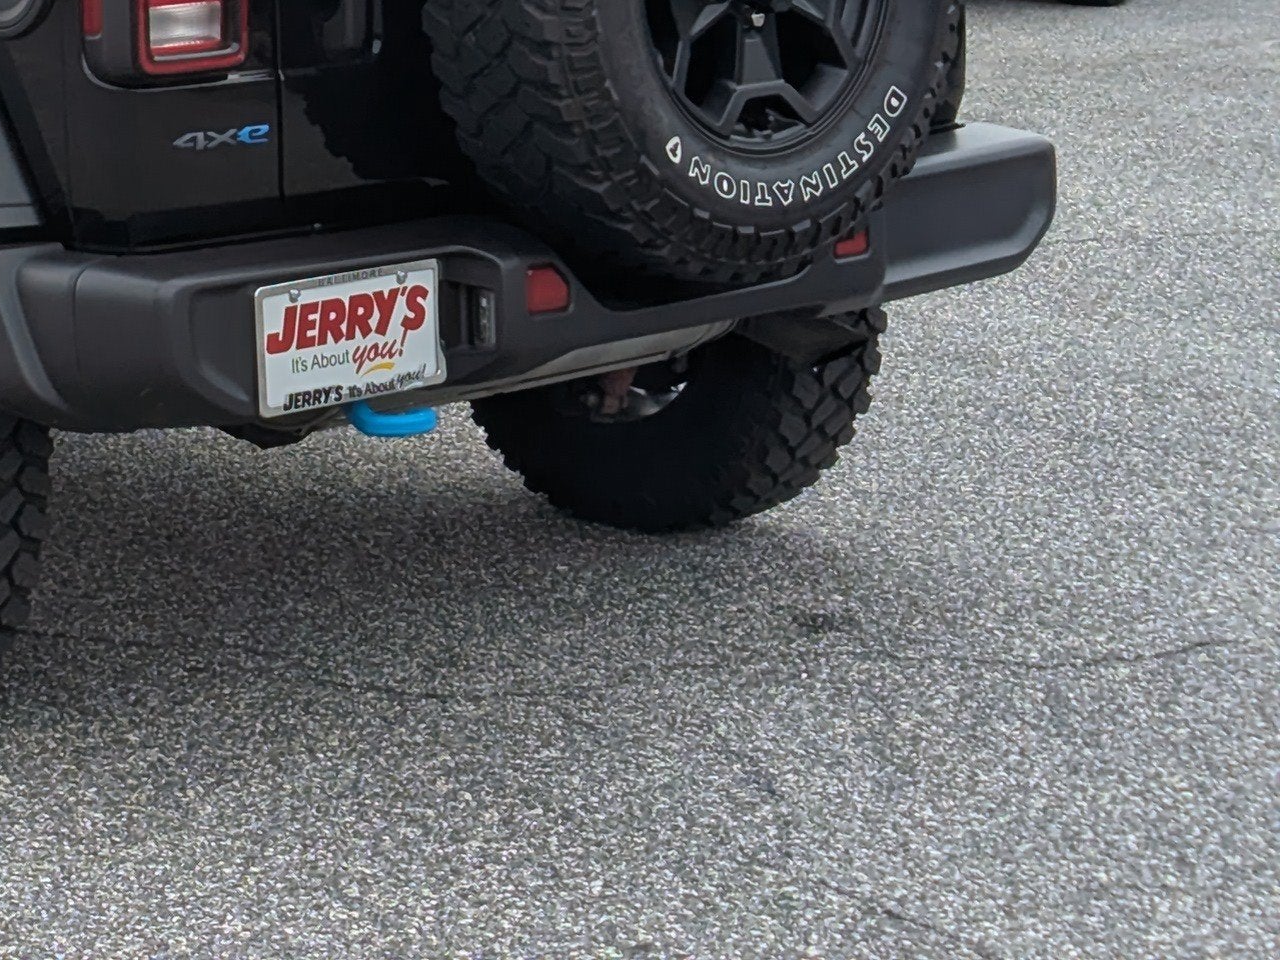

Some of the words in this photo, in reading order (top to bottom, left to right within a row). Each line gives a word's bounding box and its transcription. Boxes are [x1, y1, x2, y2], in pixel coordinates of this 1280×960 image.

[688, 86, 908, 207] DESTINATION
[319, 268, 384, 287] BALTIMORE
[266, 284, 429, 355] JERRY'S
[291, 357, 309, 374] It's
[310, 350, 351, 371] About
[282, 384, 344, 412] JERRY'S
[364, 377, 396, 396] About
